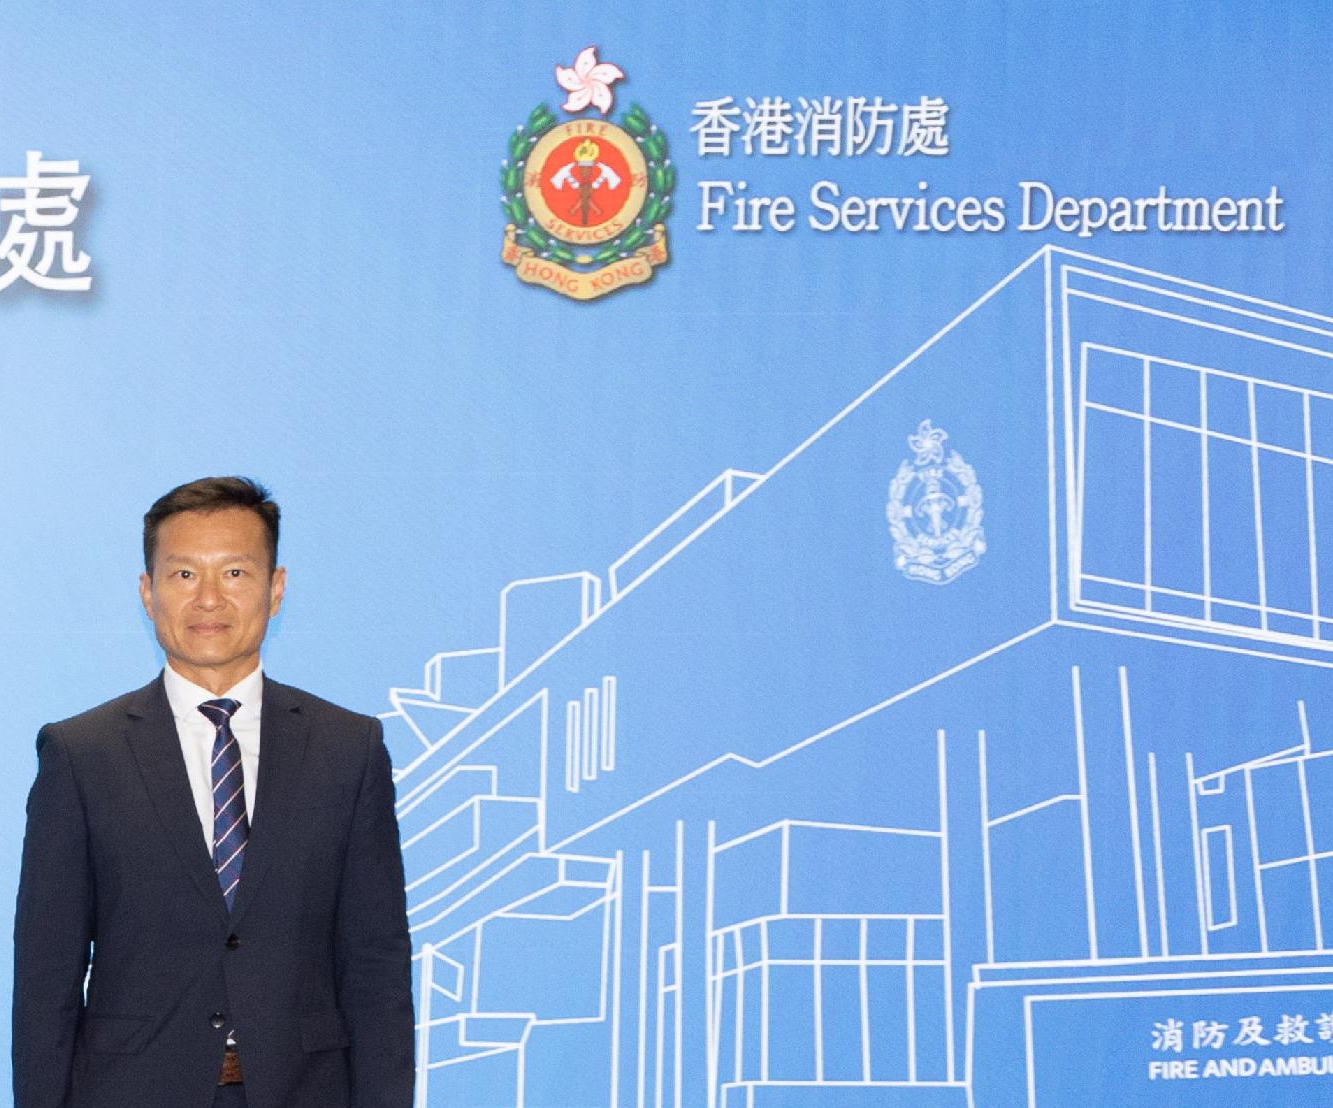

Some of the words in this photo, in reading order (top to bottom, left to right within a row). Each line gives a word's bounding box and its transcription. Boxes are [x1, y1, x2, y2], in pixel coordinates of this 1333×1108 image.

[565, 122, 610, 135] FIRE
[689, 95, 949, 156] 香港消防處
[696, 181, 795, 232] Fire
[808, 181, 1006, 233] Services
[1017, 181, 1285, 237] Department
[547, 218, 623, 241] SERVICES
[523, 262, 579, 292] HONG
[590, 262, 644, 290] KONG
[1149, 1060, 1199, 1080] FIRE
[1204, 1057, 1257, 1079] AND
